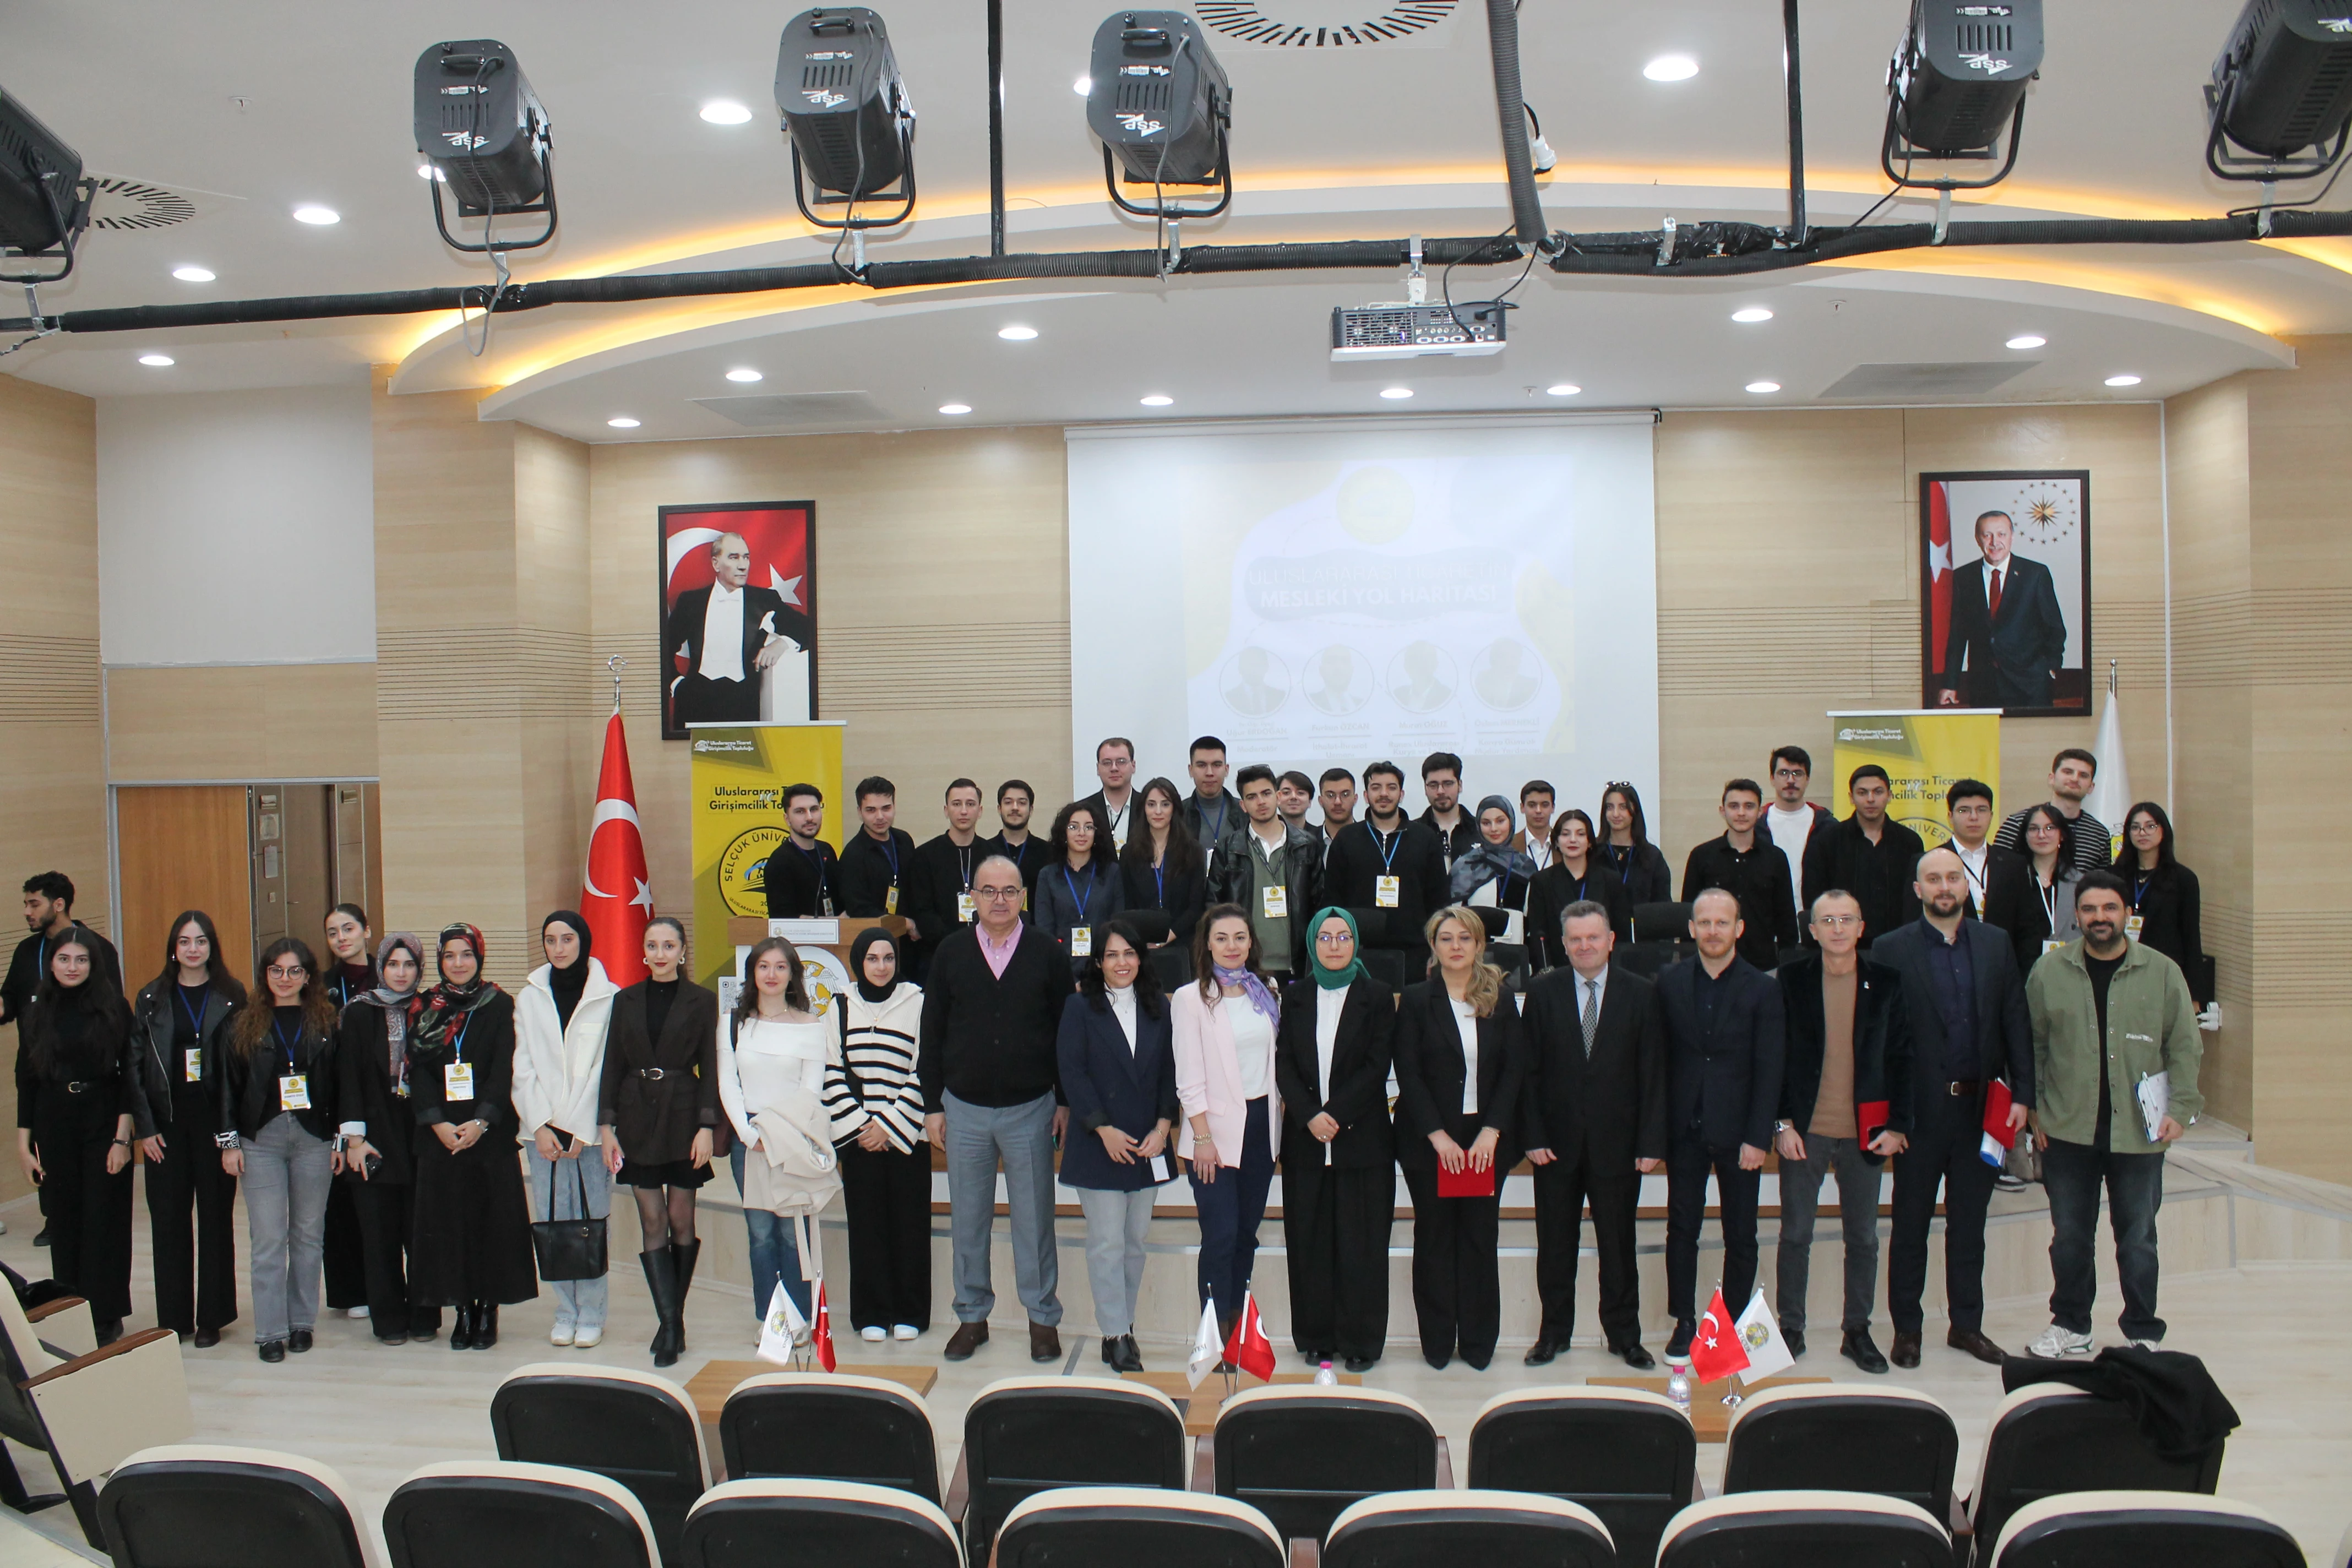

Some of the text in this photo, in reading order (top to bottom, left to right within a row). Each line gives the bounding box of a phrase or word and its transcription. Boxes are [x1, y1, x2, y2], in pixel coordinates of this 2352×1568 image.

[1969, 59, 2008, 69] SSP
[810, 94, 845, 104] SSP
[1124, 120, 1161, 130] SSP
[451, 135, 486, 148] SSP
[1261, 584, 1347, 608] MESLEKİ
[1353, 587, 1395, 605] YOL
[715, 786, 779, 796] Uluslararası
[710, 800, 769, 813] Girişimcilik
[725, 839, 750, 881] SELÇUK
